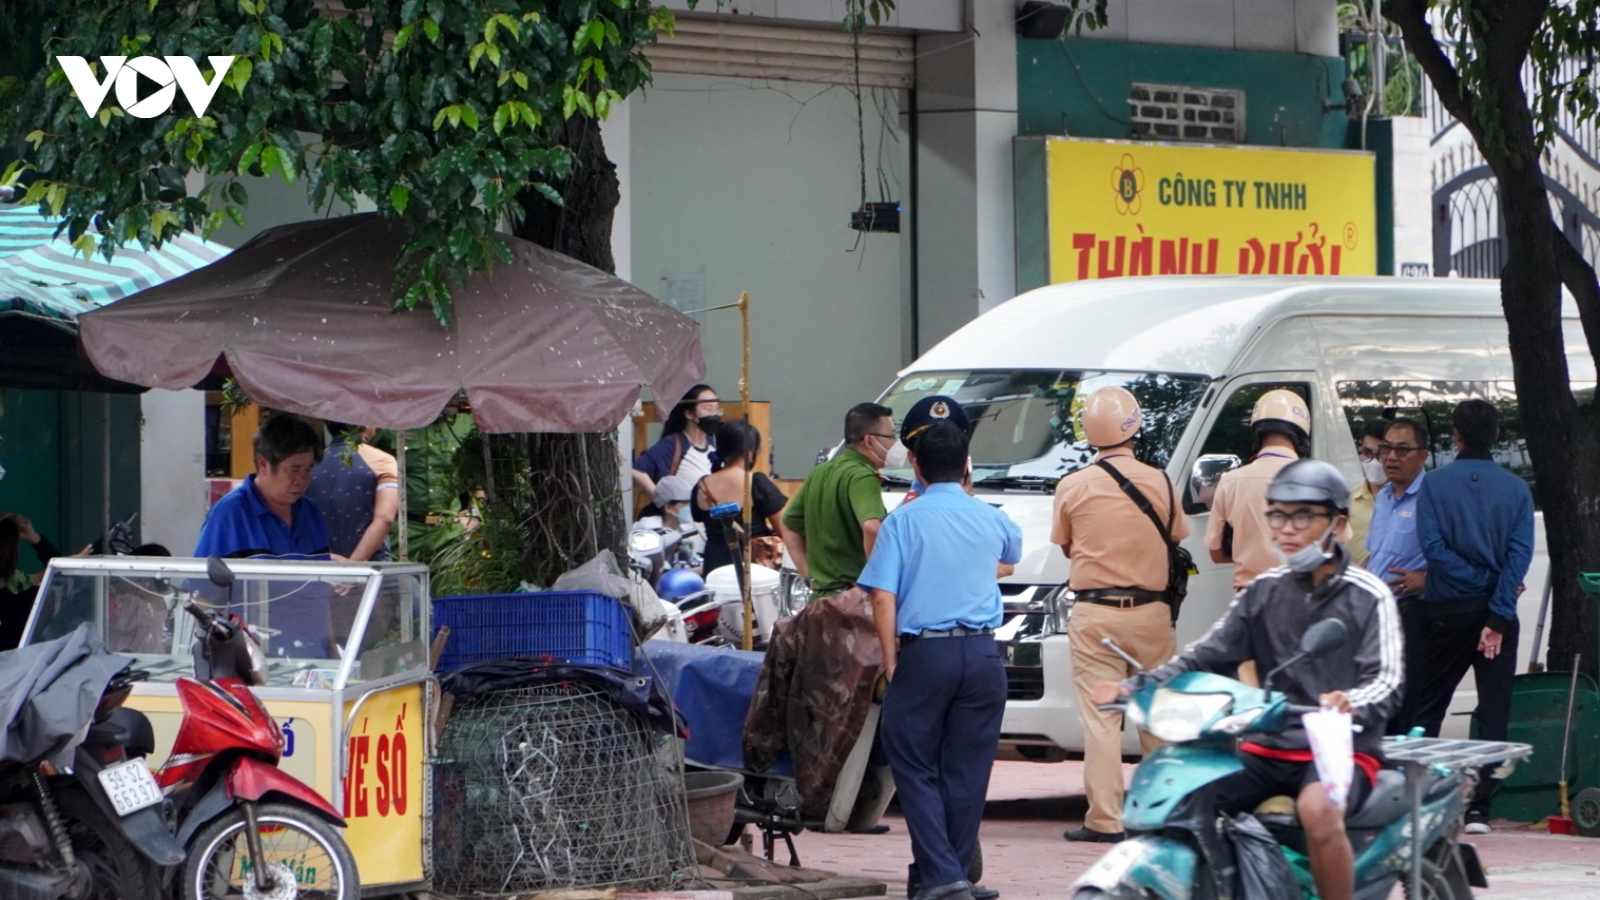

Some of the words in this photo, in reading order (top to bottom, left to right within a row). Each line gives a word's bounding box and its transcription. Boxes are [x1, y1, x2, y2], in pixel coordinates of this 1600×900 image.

[1158, 172, 1217, 207] CÔNG
[1222, 180, 1247, 208] TY
[1253, 181, 1308, 211] TNHH
[343, 716, 370, 818] VÉ
[375, 702, 408, 817] SỐ
